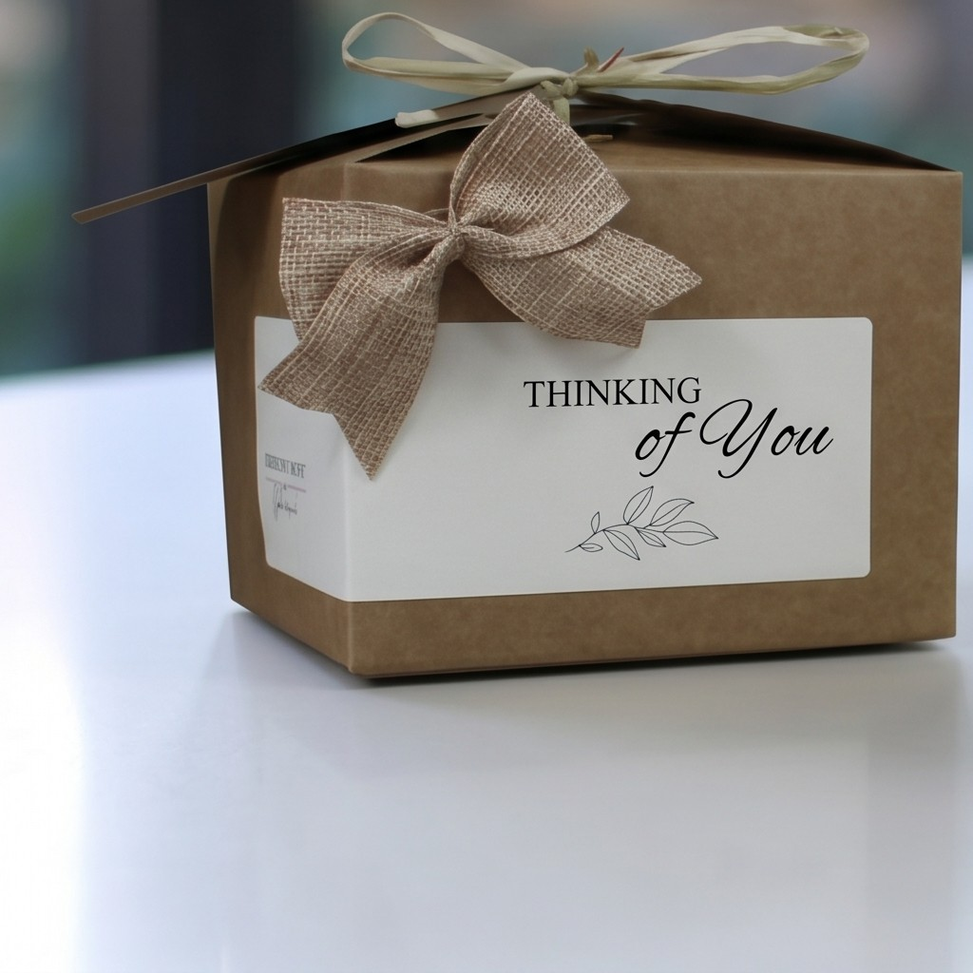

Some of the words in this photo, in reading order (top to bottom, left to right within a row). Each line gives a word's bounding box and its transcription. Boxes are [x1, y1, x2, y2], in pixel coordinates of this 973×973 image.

[523, 377, 701, 407] THINKING
[635, 412, 696, 477] of
[699, 399, 834, 479] You
